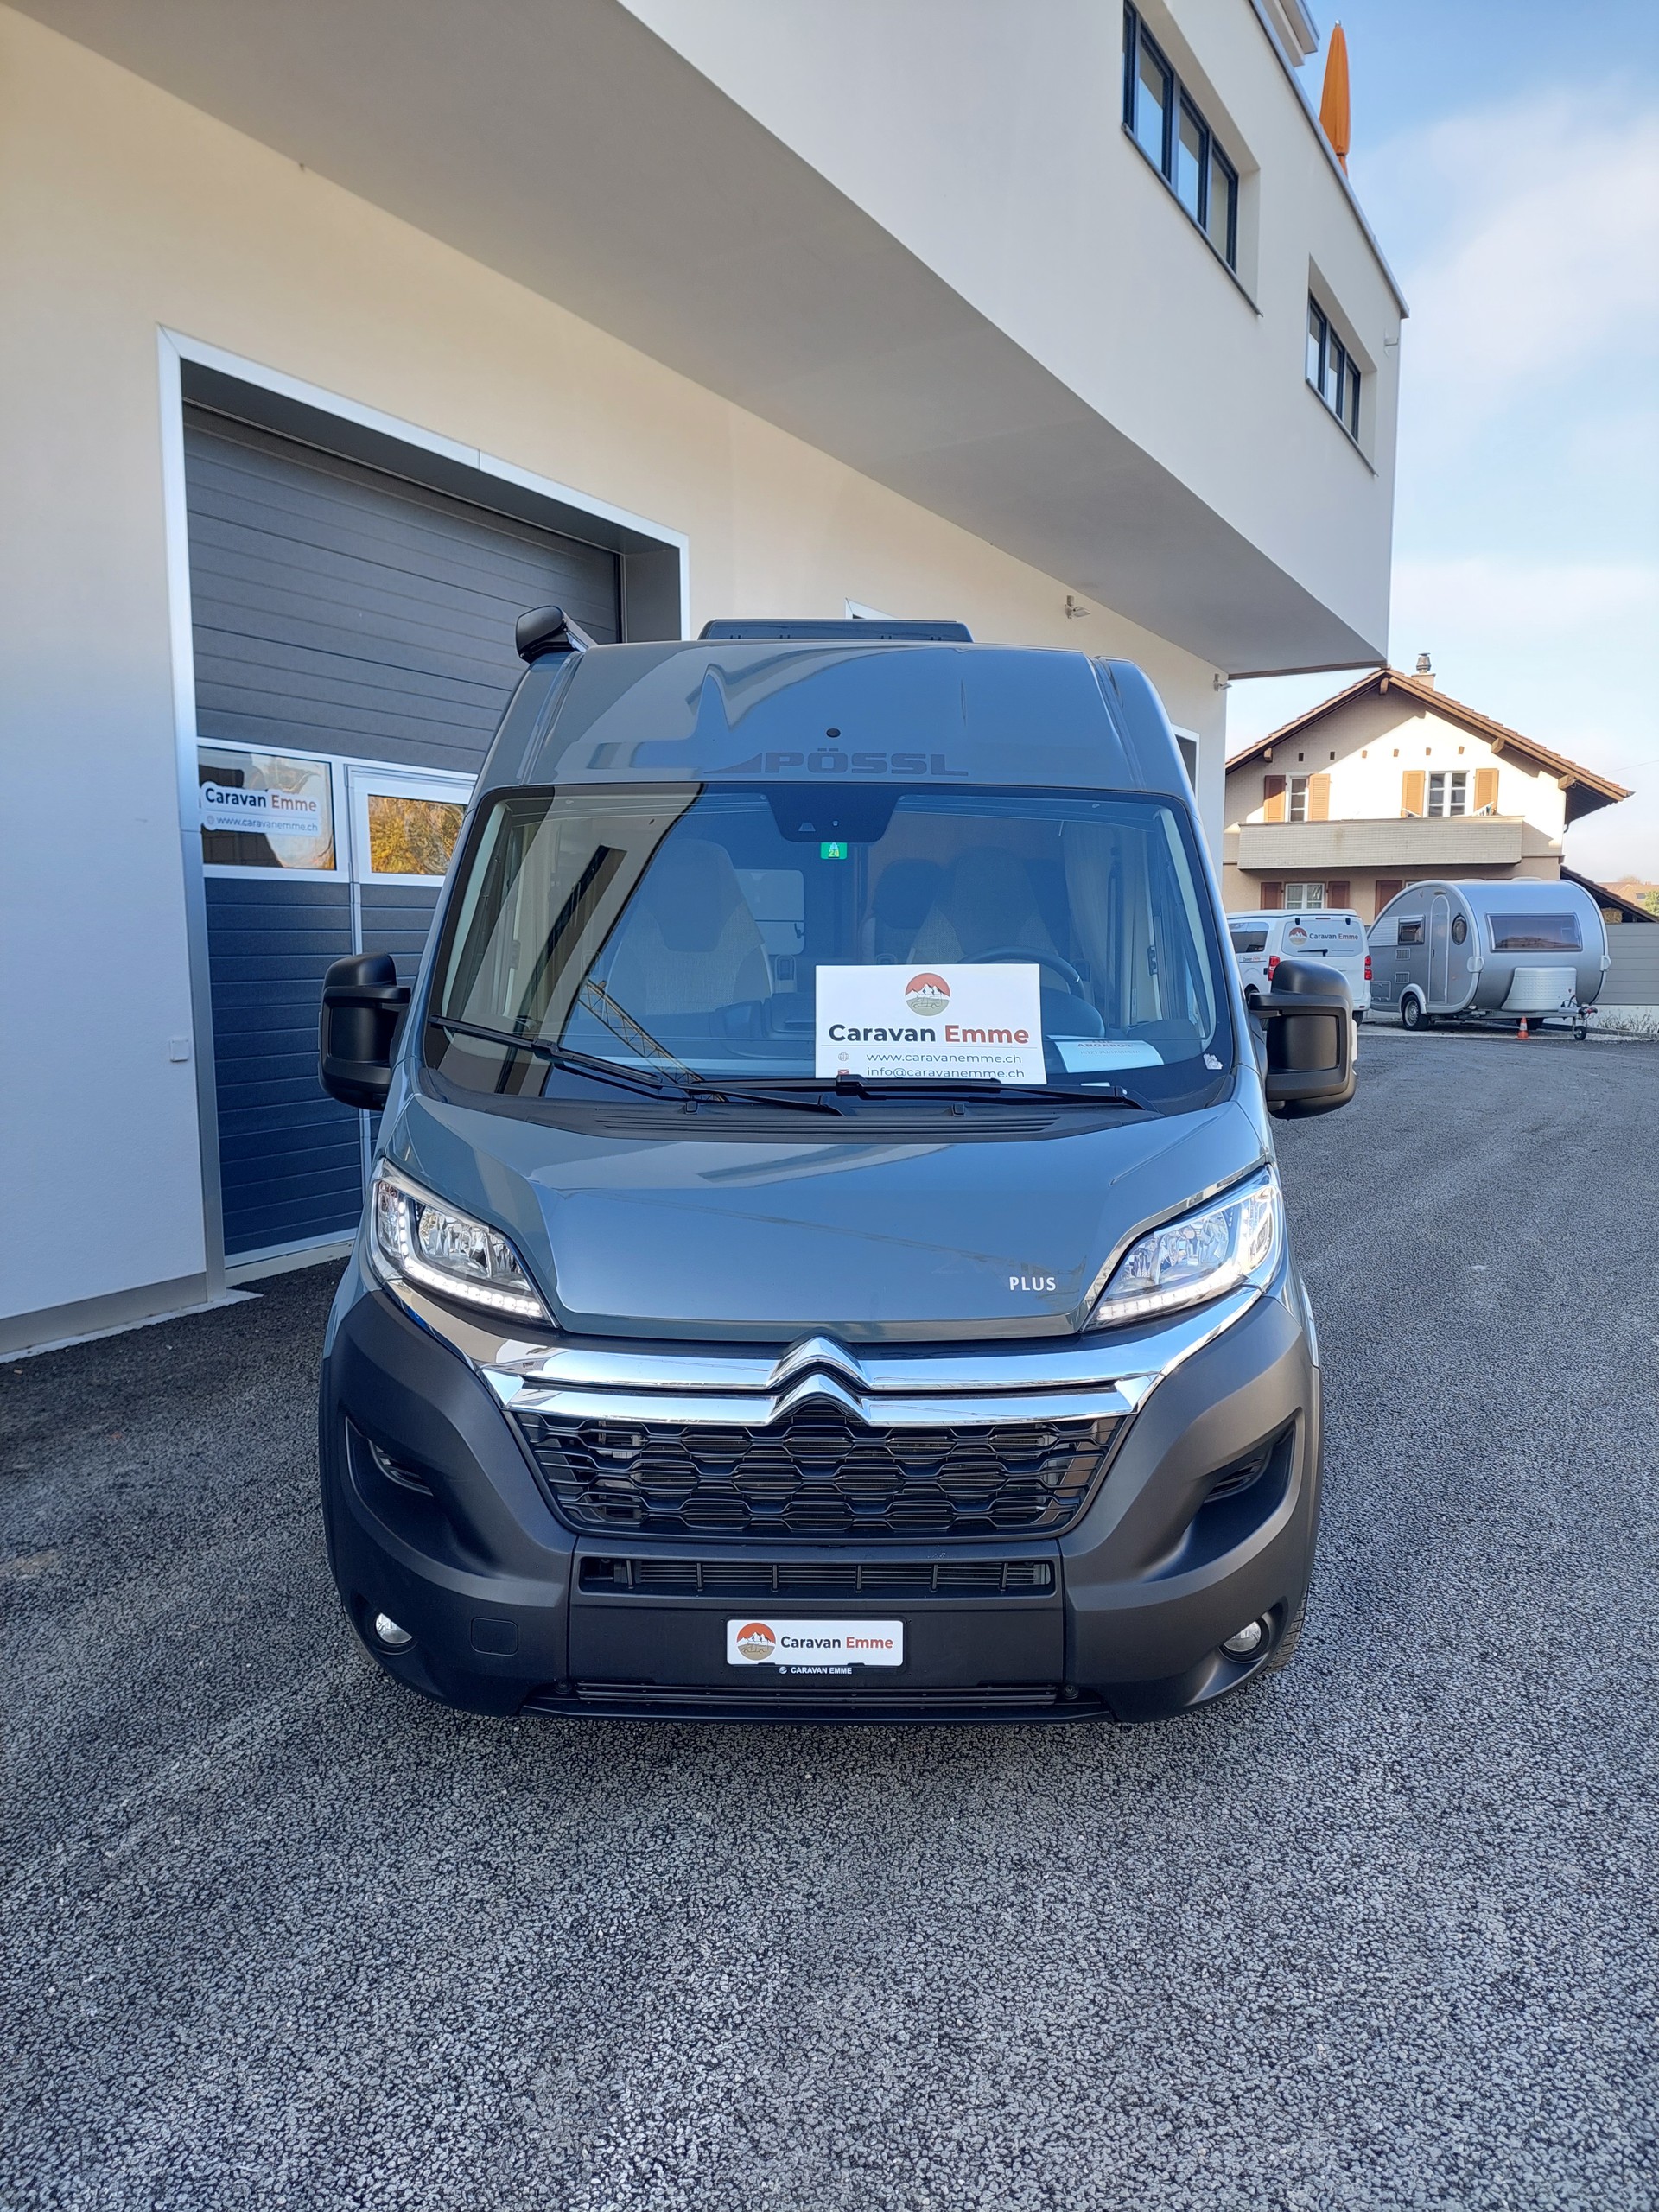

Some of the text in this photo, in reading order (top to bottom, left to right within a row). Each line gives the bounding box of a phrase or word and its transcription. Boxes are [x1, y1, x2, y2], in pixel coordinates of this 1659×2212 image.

[765, 747, 969, 776] PÖSSL
[205, 787, 317, 812] Caravan Emme
[216, 816, 318, 832] www.caravanemme.ch
[828, 1024, 1030, 1045] Caravan Emme
[866, 1053, 1022, 1064] www.caravanemme.ch
[866, 1066, 1025, 1078] info@caravanemme.ch
[1008, 1276, 1057, 1292] PLUS
[780, 1636, 893, 1649] Caravan Emme
